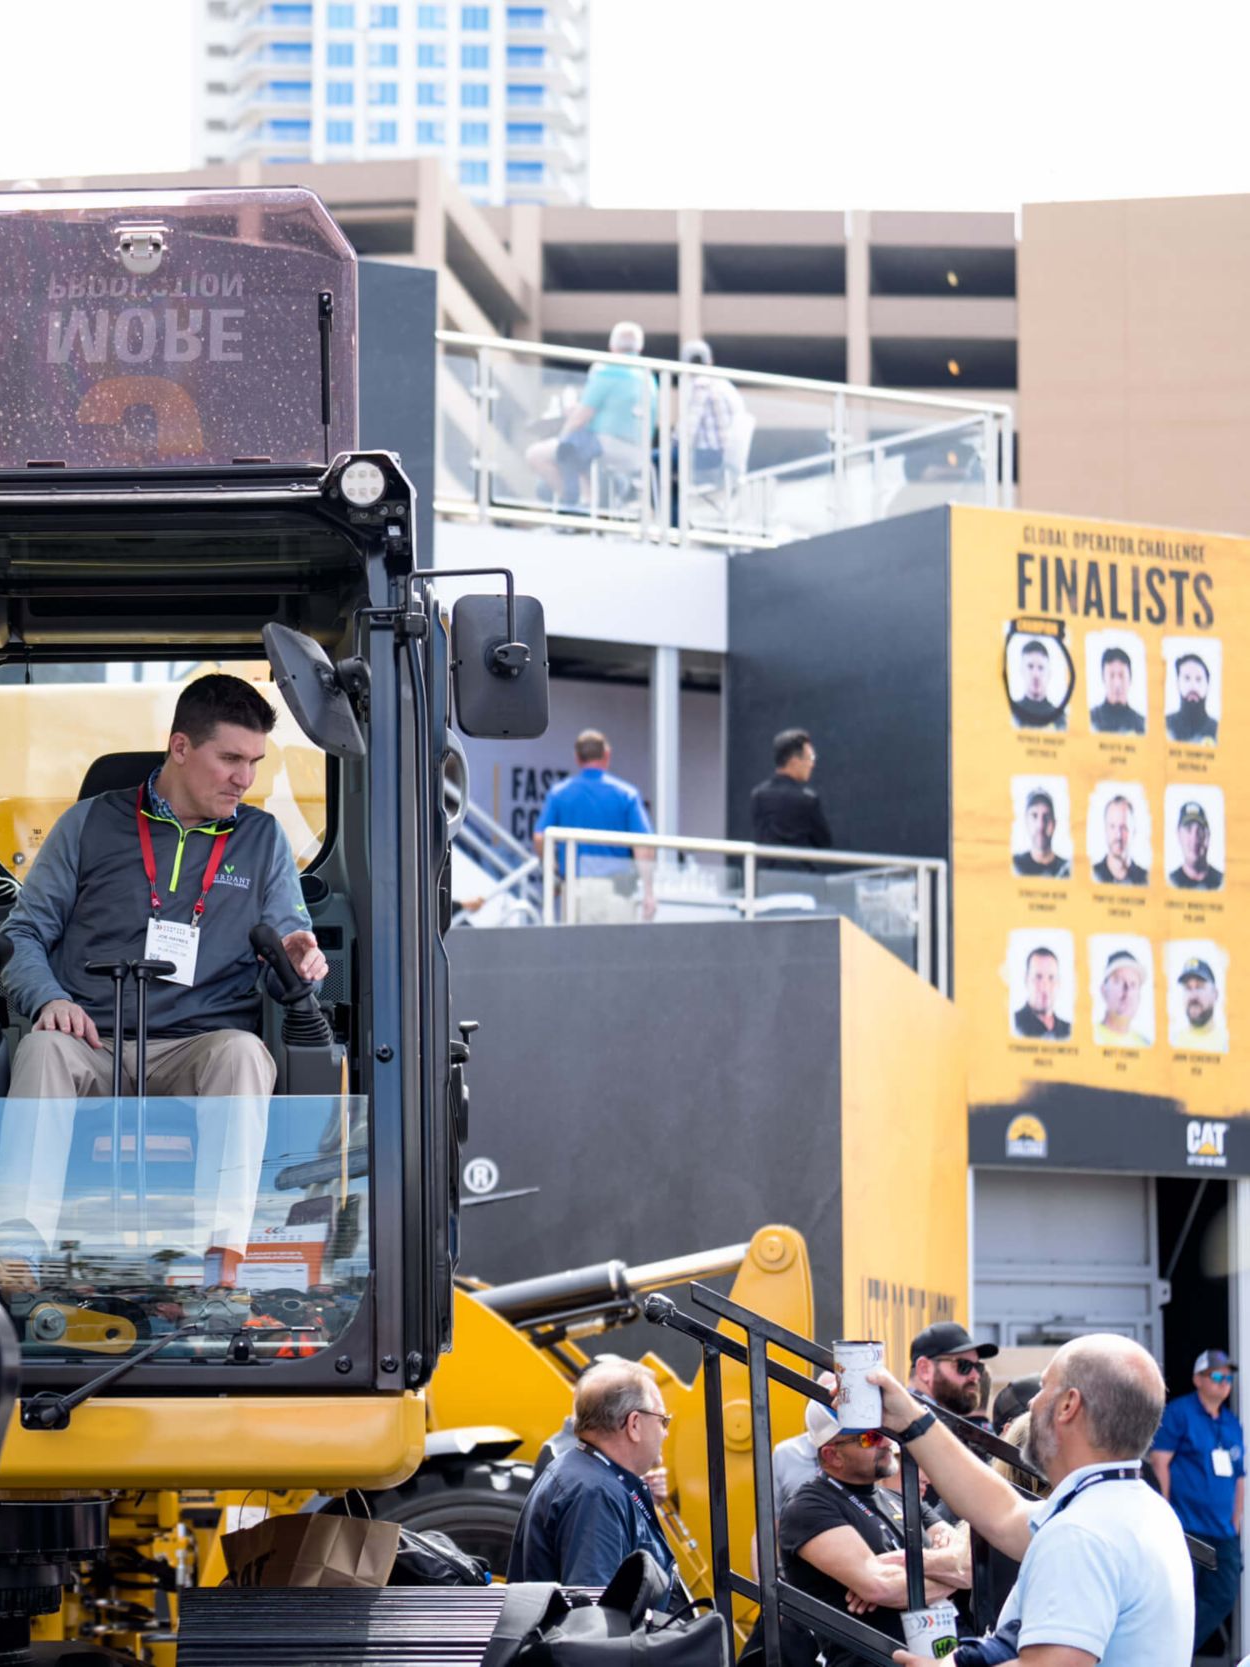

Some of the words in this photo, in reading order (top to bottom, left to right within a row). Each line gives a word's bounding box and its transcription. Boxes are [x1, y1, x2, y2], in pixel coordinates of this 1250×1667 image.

[1023, 525, 1068, 549] GLOBAL
[1073, 531, 1135, 557] OPERATOR
[1137, 539, 1206, 564] CHALLENGE
[1017, 552, 1215, 631] FINALISTS
[511, 767, 570, 802] FAS
[214, 874, 251, 886] ERDANT
[1186, 1119, 1230, 1156] CAT
